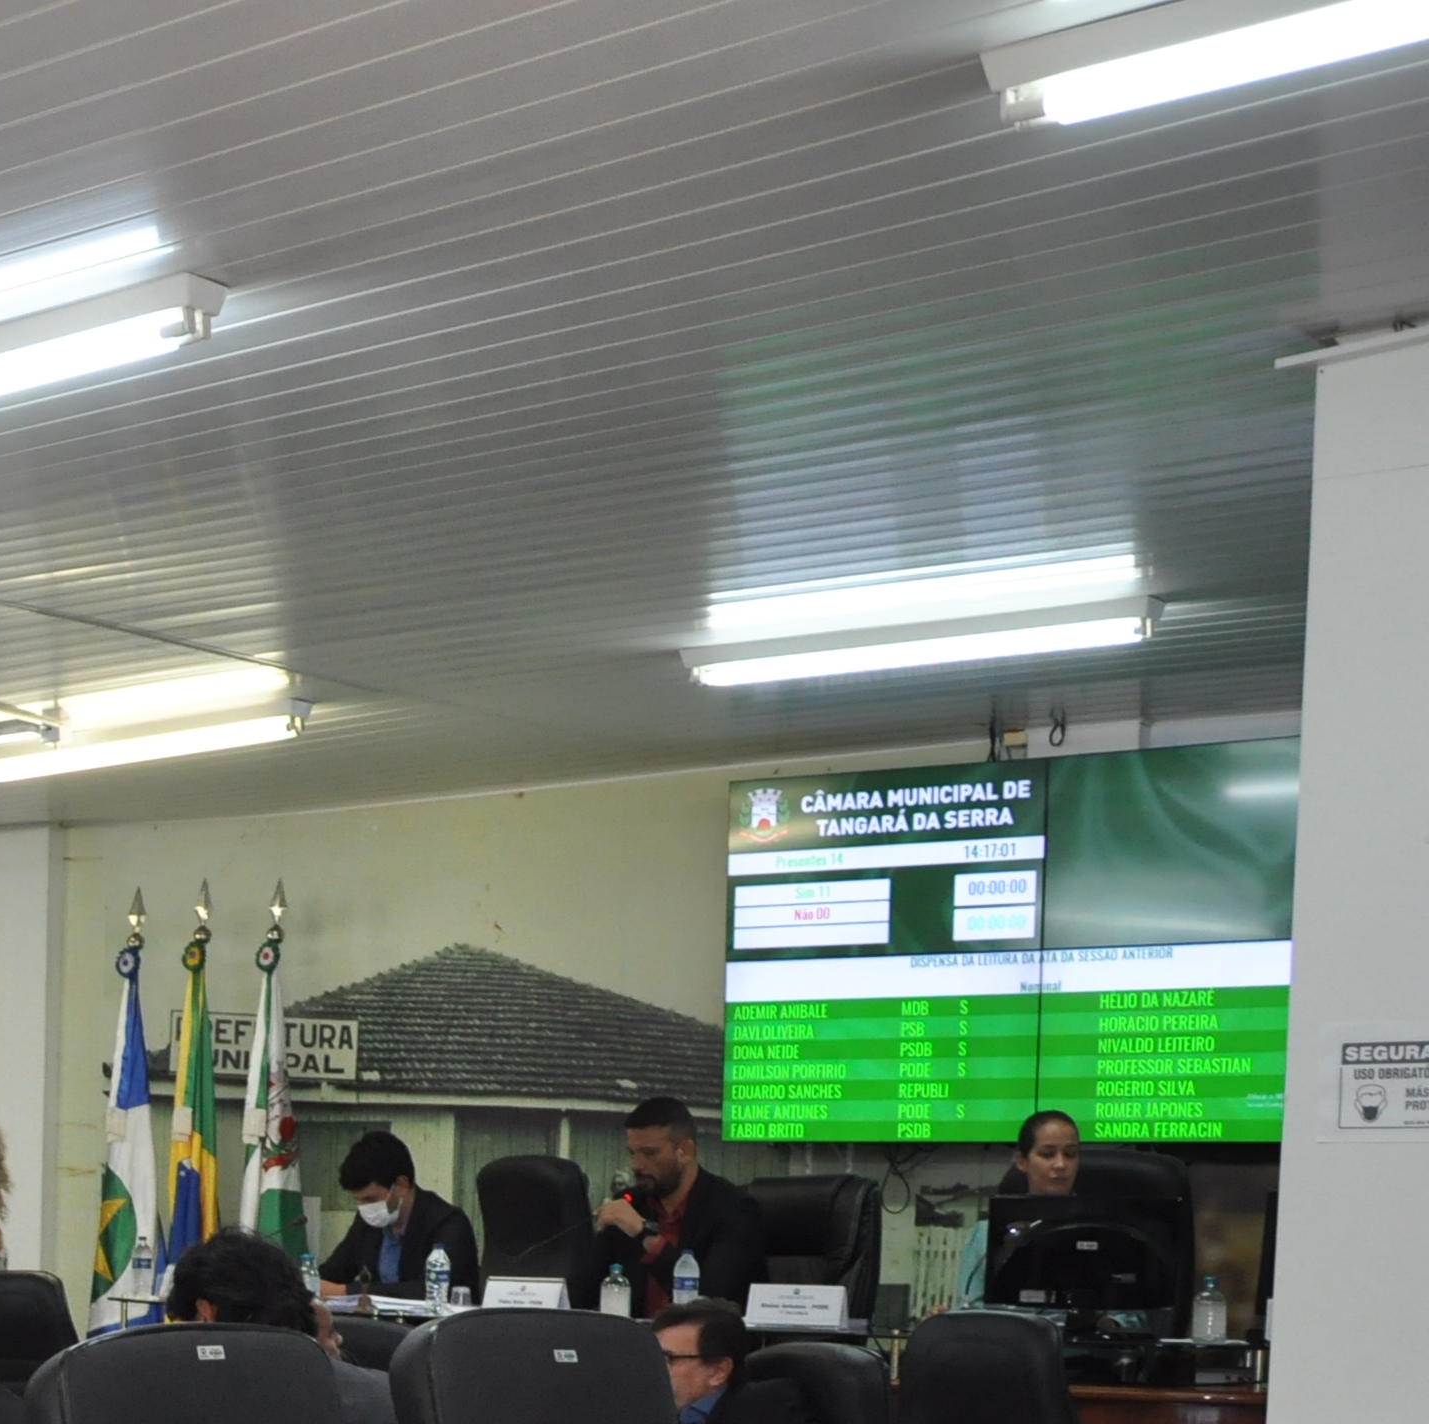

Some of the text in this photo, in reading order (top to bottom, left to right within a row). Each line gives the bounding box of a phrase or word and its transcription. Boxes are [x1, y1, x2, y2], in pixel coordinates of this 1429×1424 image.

[800, 780, 1031, 813] CÂMARA MUNICIPAL DE
[816, 807, 1013, 837] TANGARÁ DA SERRA
[964, 842, 1016, 859] 14:17:01
[776, 852, 843, 869] Presentes 14
[795, 885, 830, 900] Sim 11
[968, 879, 1027, 896] 00:00:00
[794, 907, 830, 921] Não 00
[967, 914, 1026, 930] 00:00:00
[910, 955, 958, 968] DISPENSA
[961, 955, 975, 966] DA
[978, 953, 1018, 966] LEITURA
[1022, 952, 1035, 964] DA
[1039, 951, 1058, 964] ATA
[1060, 950, 1074, 963] DA
[1121, 947, 1174, 960] ANTERIOR
[1020, 981, 1062, 993] Nominal
[1099, 988, 1215, 1009] HÉLIO DA NAZARÉ
[733, 1003, 828, 1020] ADEMIR ANIBALE
[901, 1000, 929, 1016] MDB
[959, 999, 969, 1015] S
[901, 1021, 925, 1037] PSB
[959, 1020, 968, 1036] S
[1099, 1014, 1218, 1032] HORACIO PEREIRA
[175, 1016, 354, 1050] EFTURA
[733, 1024, 814, 1040] DAVI OLIVEIRA
[733, 1044, 800, 1060] DONA NEIDE
[900, 1042, 932, 1057] PSDB
[958, 1041, 967, 1057] S
[1098, 1036, 1215, 1054] NIVALDO LEITEIRO
[1345, 1045, 1429, 1061] SEGURA
[732, 1063, 846, 1080] EDMILSON PORFIRIO
[899, 1062, 931, 1078] PODE
[957, 1062, 966, 1077] S
[1097, 1057, 1252, 1075] PROFESSOR SEBASTIAN
[1354, 1068, 1375, 1080] USO
[731, 1083, 842, 1100] EDUARDO SANCHES
[1096, 1080, 1196, 1097] ROGERIO SILVA
[731, 1104, 828, 1120] ELAINE ANTUNES
[898, 1104, 931, 1119] PODE
[956, 1103, 965, 1119] S
[1095, 1102, 1146, 1118] ROMER
[768, 1122, 805, 1138] BRITO
[897, 1123, 931, 1139] PSDB
[1094, 1121, 1222, 1138] SANDRA FERRACIN
